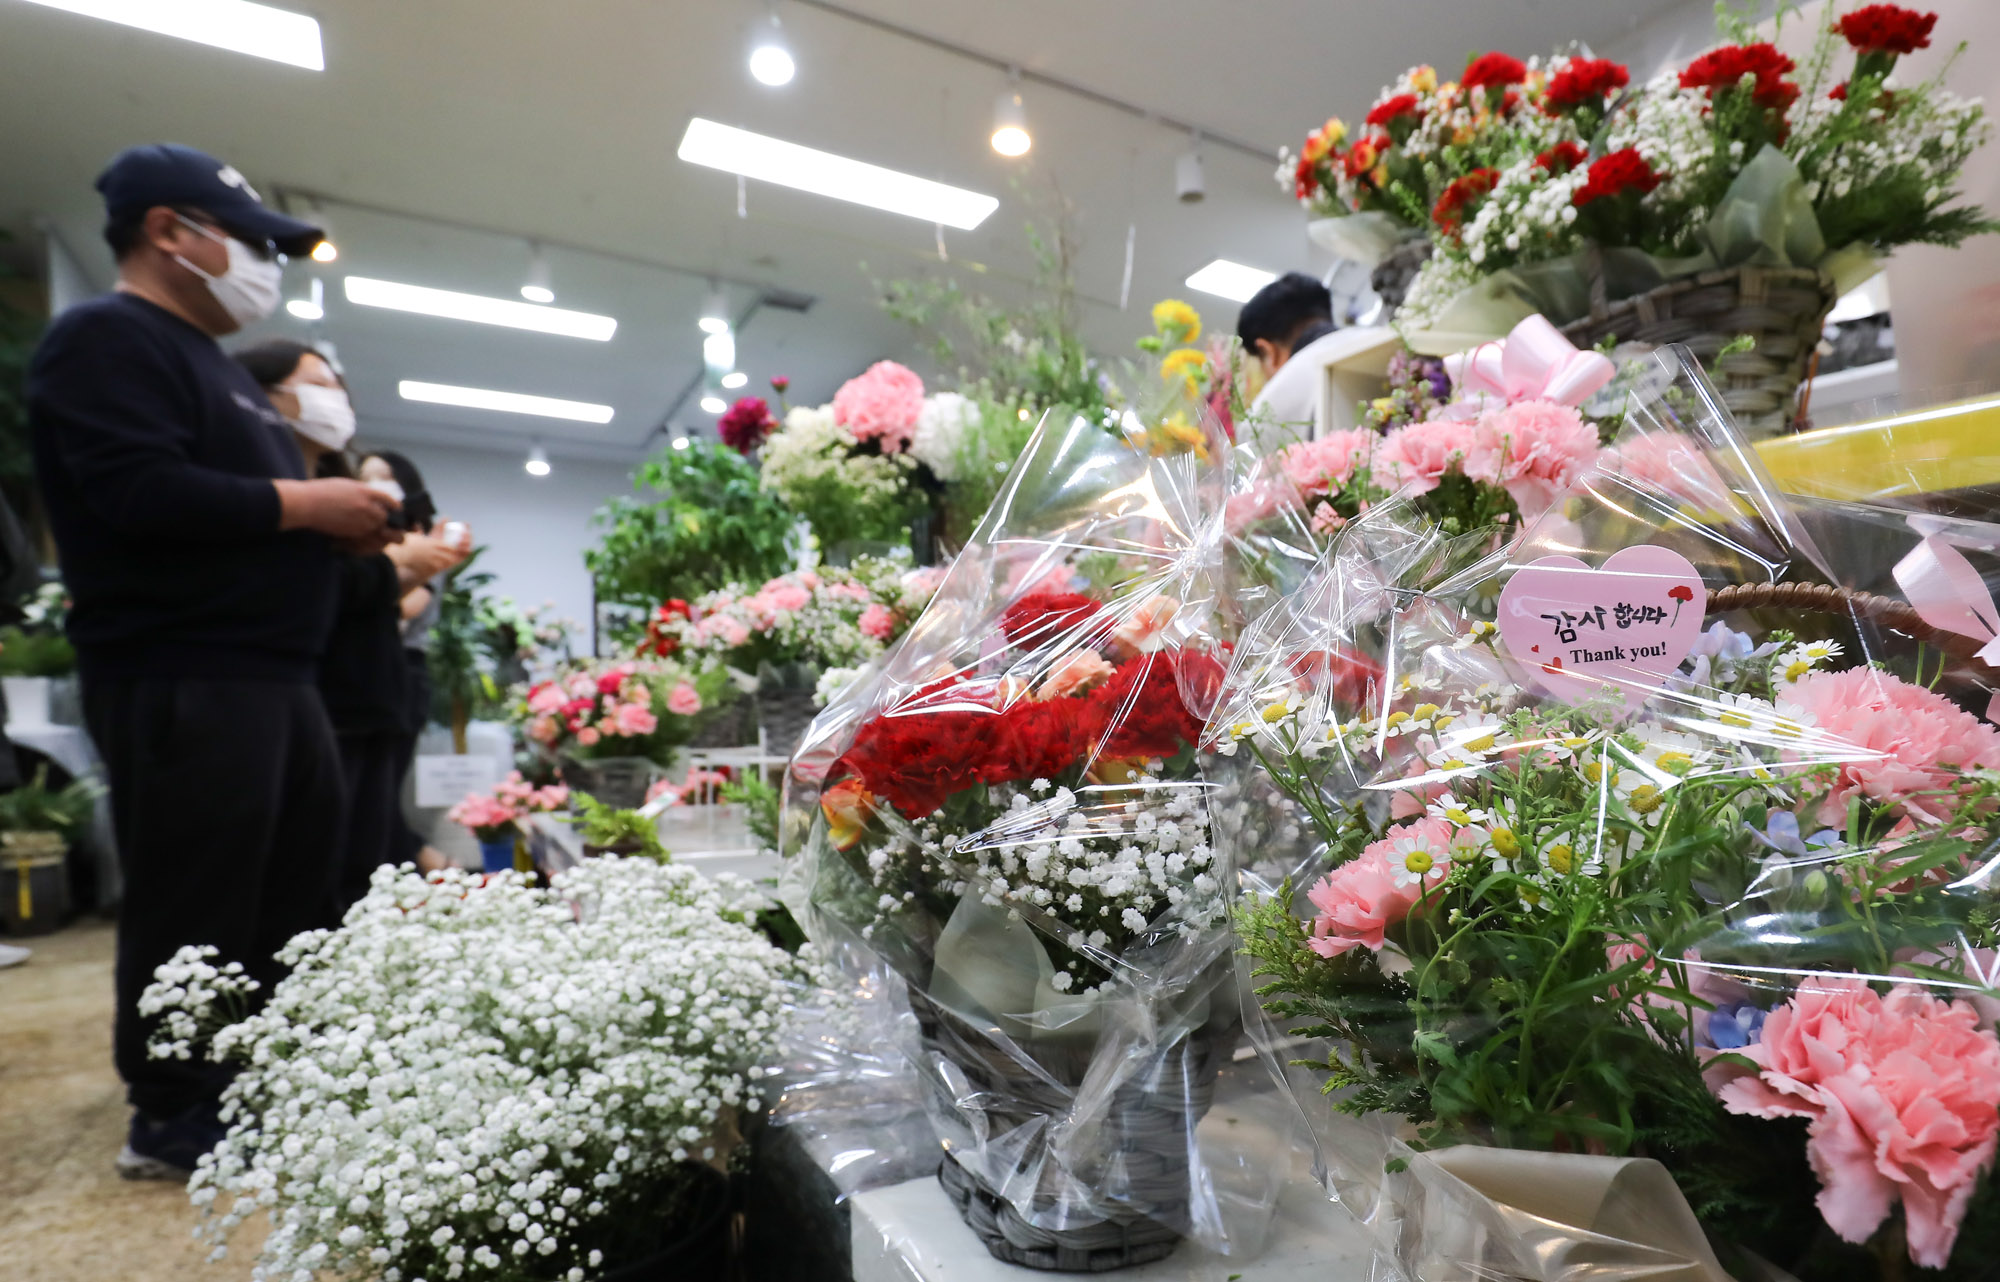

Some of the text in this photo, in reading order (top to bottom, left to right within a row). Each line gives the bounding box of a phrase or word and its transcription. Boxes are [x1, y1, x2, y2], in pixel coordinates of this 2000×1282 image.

[1541, 602, 1667, 643] 감사 합니다
[1571, 641, 1667, 663] Thank you!
